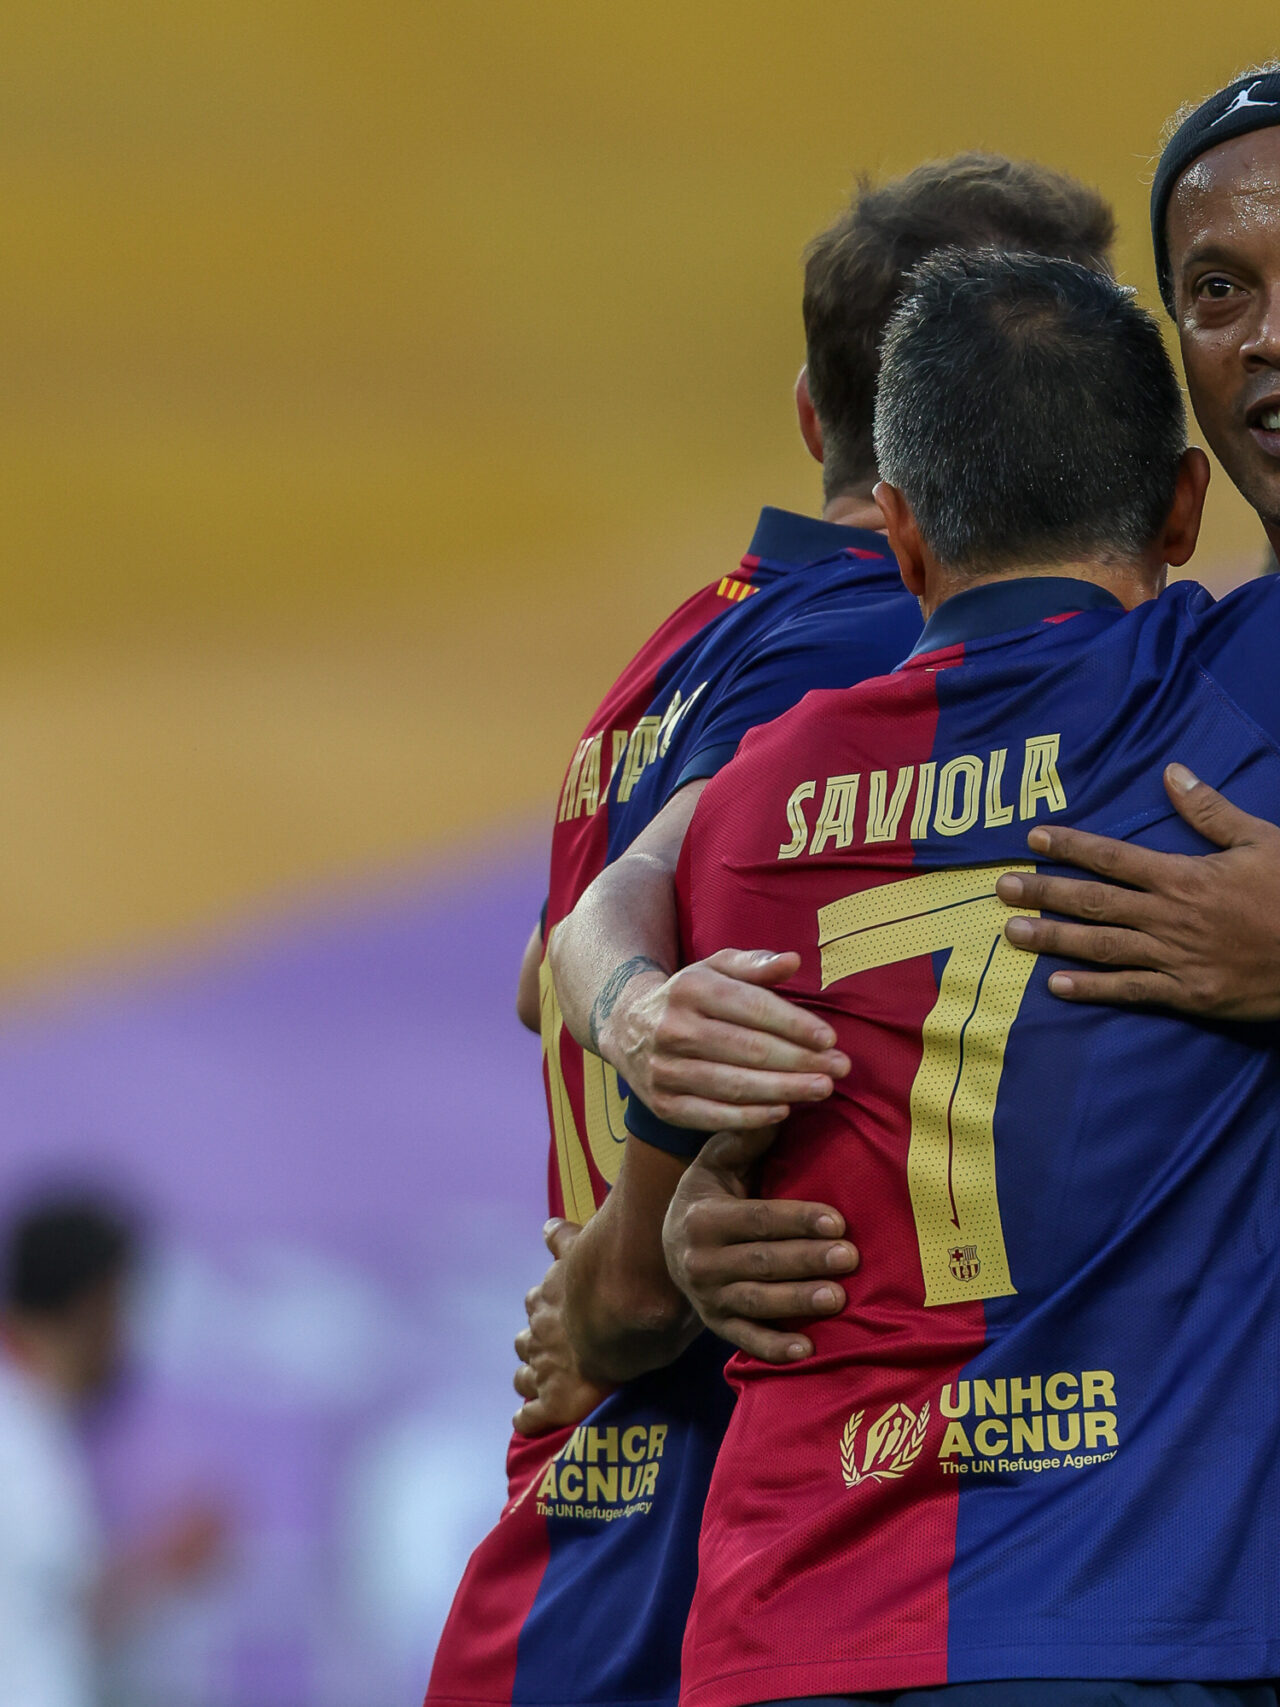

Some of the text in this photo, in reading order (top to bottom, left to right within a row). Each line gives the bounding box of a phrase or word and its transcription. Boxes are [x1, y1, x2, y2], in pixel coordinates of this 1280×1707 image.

[777, 733, 1067, 860] SAVIOLA
[818, 862, 1041, 1307] 7
[939, 1370, 1117, 1418] UNHCR
[938, 1411, 1119, 1459] ACNUR
[536, 1462, 659, 1503] ACNUR
[940, 1450, 1118, 1474] The UN Refugee Agency
[536, 1502, 554, 1516] The
[555, 1504, 573, 1517] UN
